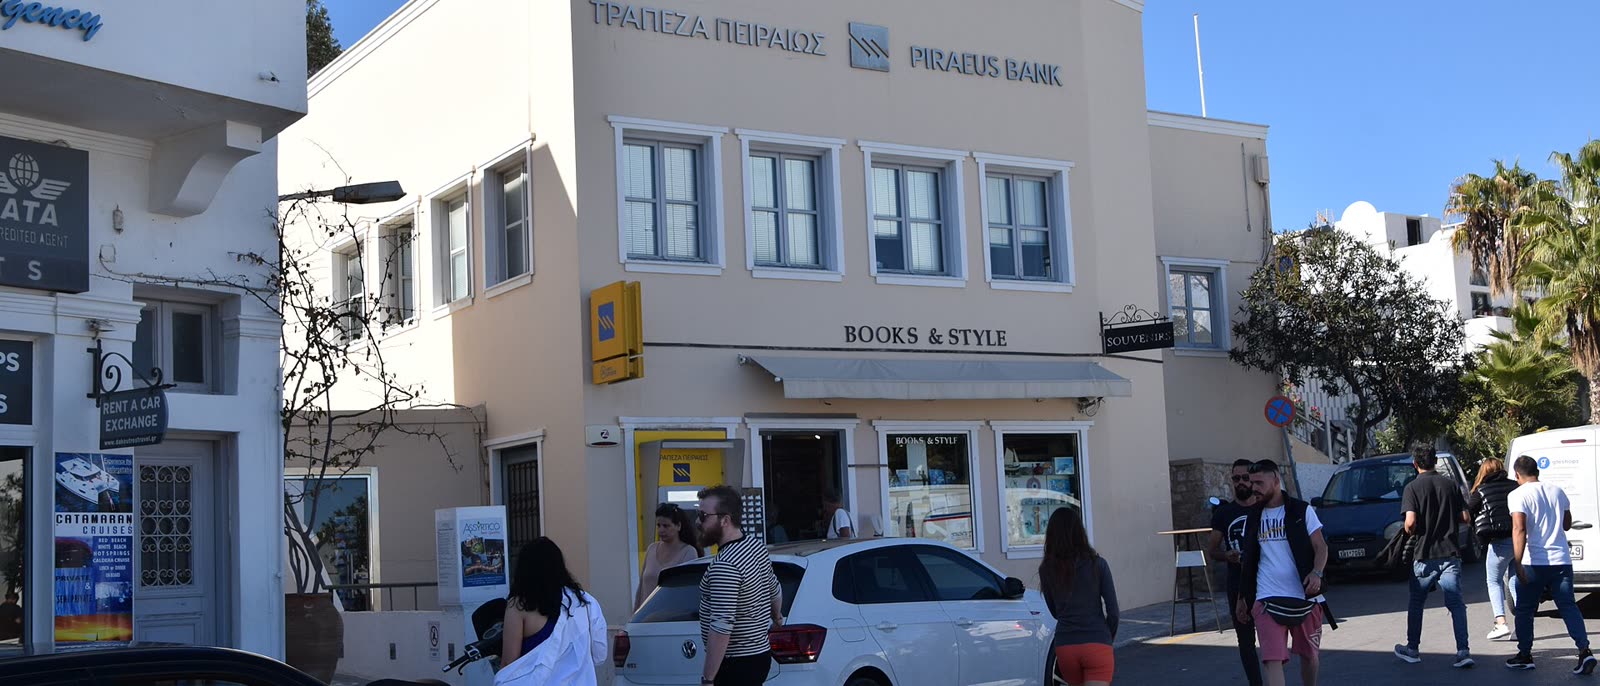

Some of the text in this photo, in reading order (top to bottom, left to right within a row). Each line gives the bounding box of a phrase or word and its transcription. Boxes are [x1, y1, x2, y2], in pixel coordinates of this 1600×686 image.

[589, 0, 827, 56] ΤΡΑΠΕΖΑ ΠΕΙΡΑΙΩΣ
[910, 45, 1063, 86] PIRAEUS BANK
[40, 232, 68, 248] AGENT
[844, 325, 1008, 347] BOOKS & STYLE
[1107, 331, 1171, 347] SOUVENIRS
[103, 396, 161, 415] RENT A CAR
[105, 414, 158, 432] EXCHANGE
[895, 436, 958, 445] BOOKS & STYLE
[56, 514, 133, 524] CATAMARAN
[83, 525, 133, 535] CRUISES
[85, 582, 91, 590] &
